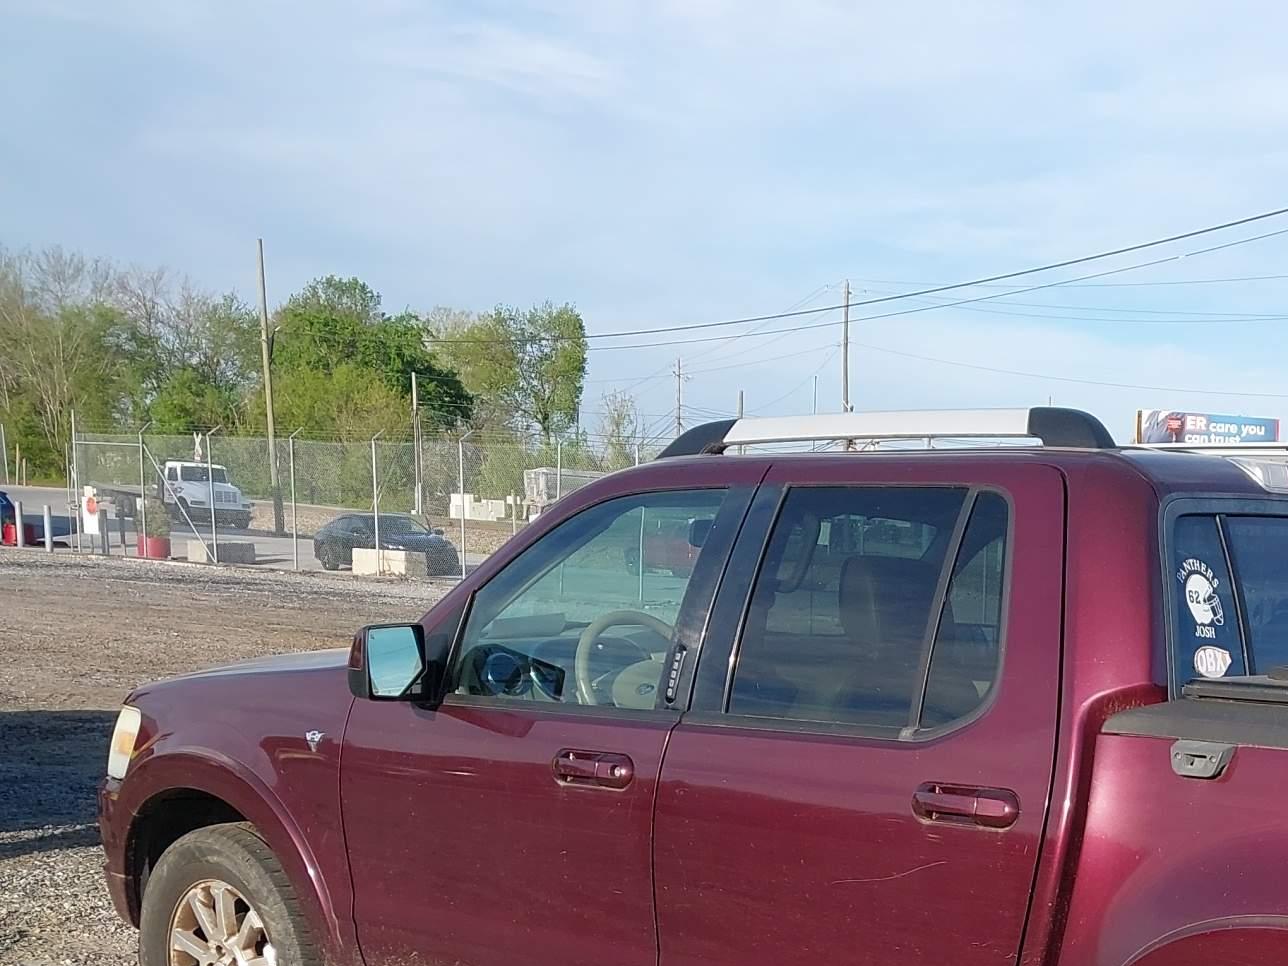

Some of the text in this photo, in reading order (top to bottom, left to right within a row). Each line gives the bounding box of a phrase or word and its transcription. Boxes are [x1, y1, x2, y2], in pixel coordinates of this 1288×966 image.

[1185, 415, 1265, 437] ER care you
[1184, 433, 1208, 443] can
[1176, 558, 1220, 588] PANTHERS
[1188, 589, 1201, 604] 62
[1195, 625, 1216, 639] JOSH
